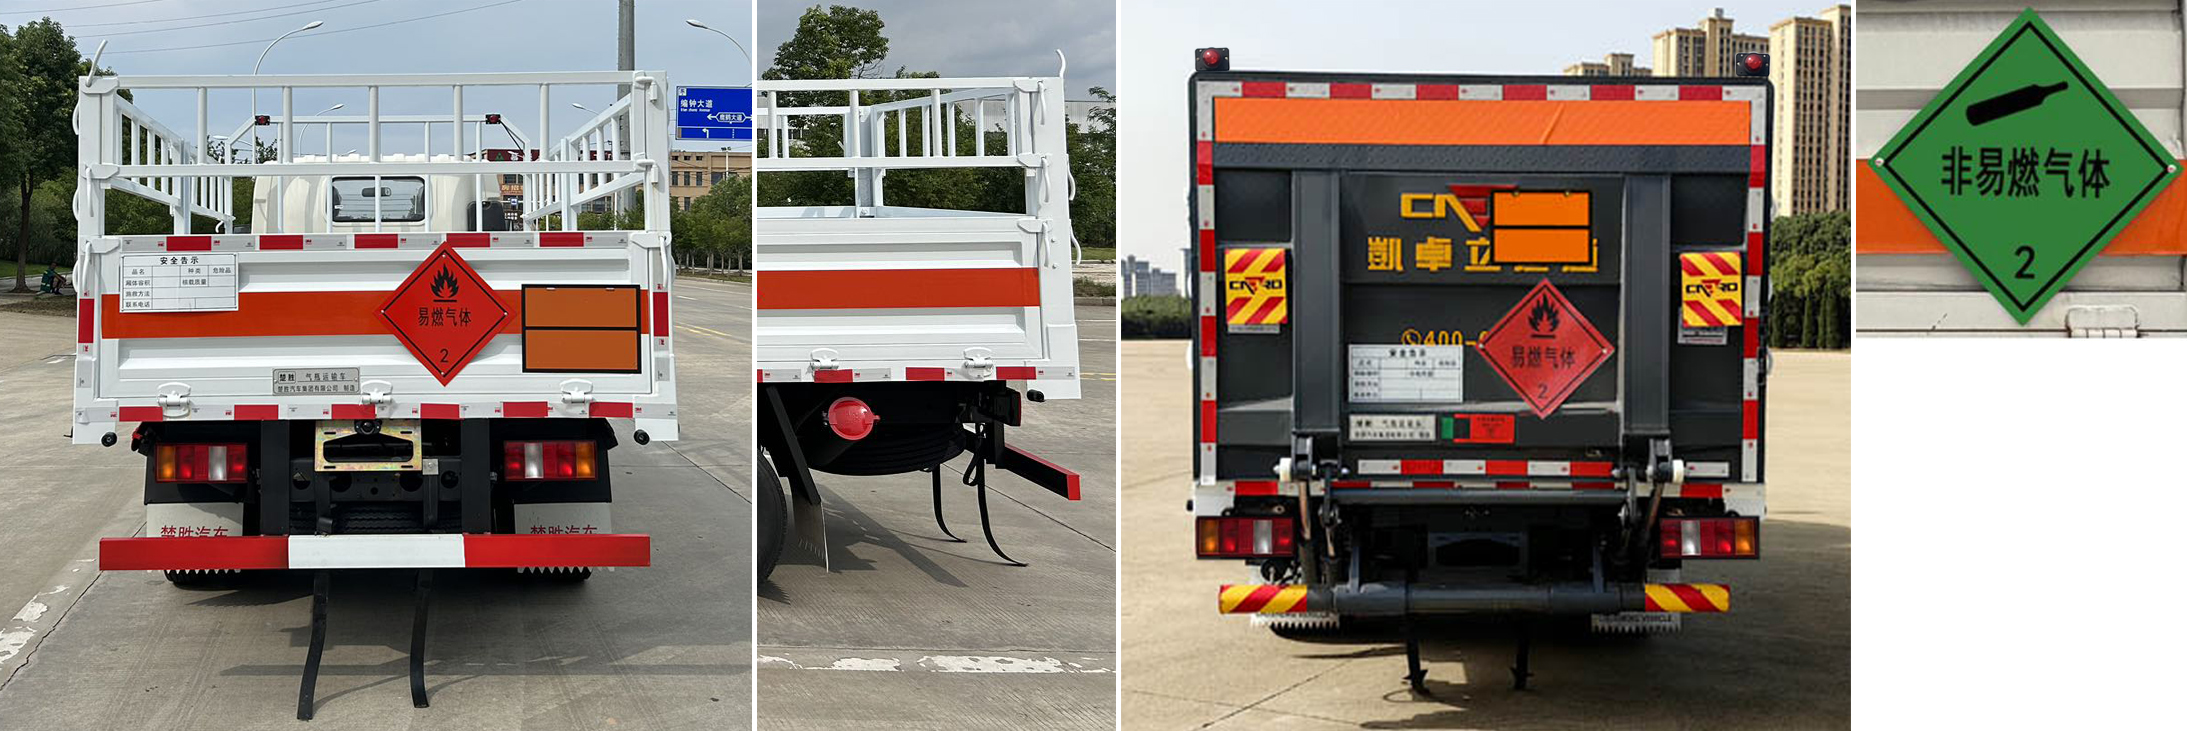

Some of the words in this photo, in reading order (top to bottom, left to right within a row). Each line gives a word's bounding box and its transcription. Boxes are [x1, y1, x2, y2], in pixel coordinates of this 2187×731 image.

[1941, 145, 2110, 199] 非易燃气体
[160, 256, 199, 265] 安全告示
[2014, 245, 2036, 279] 2
[418, 307, 472, 327] 易燃气体
[440, 348, 449, 363] 2
[1512, 345, 1576, 370] 易燃气体
[1538, 383, 1549, 399] 2
